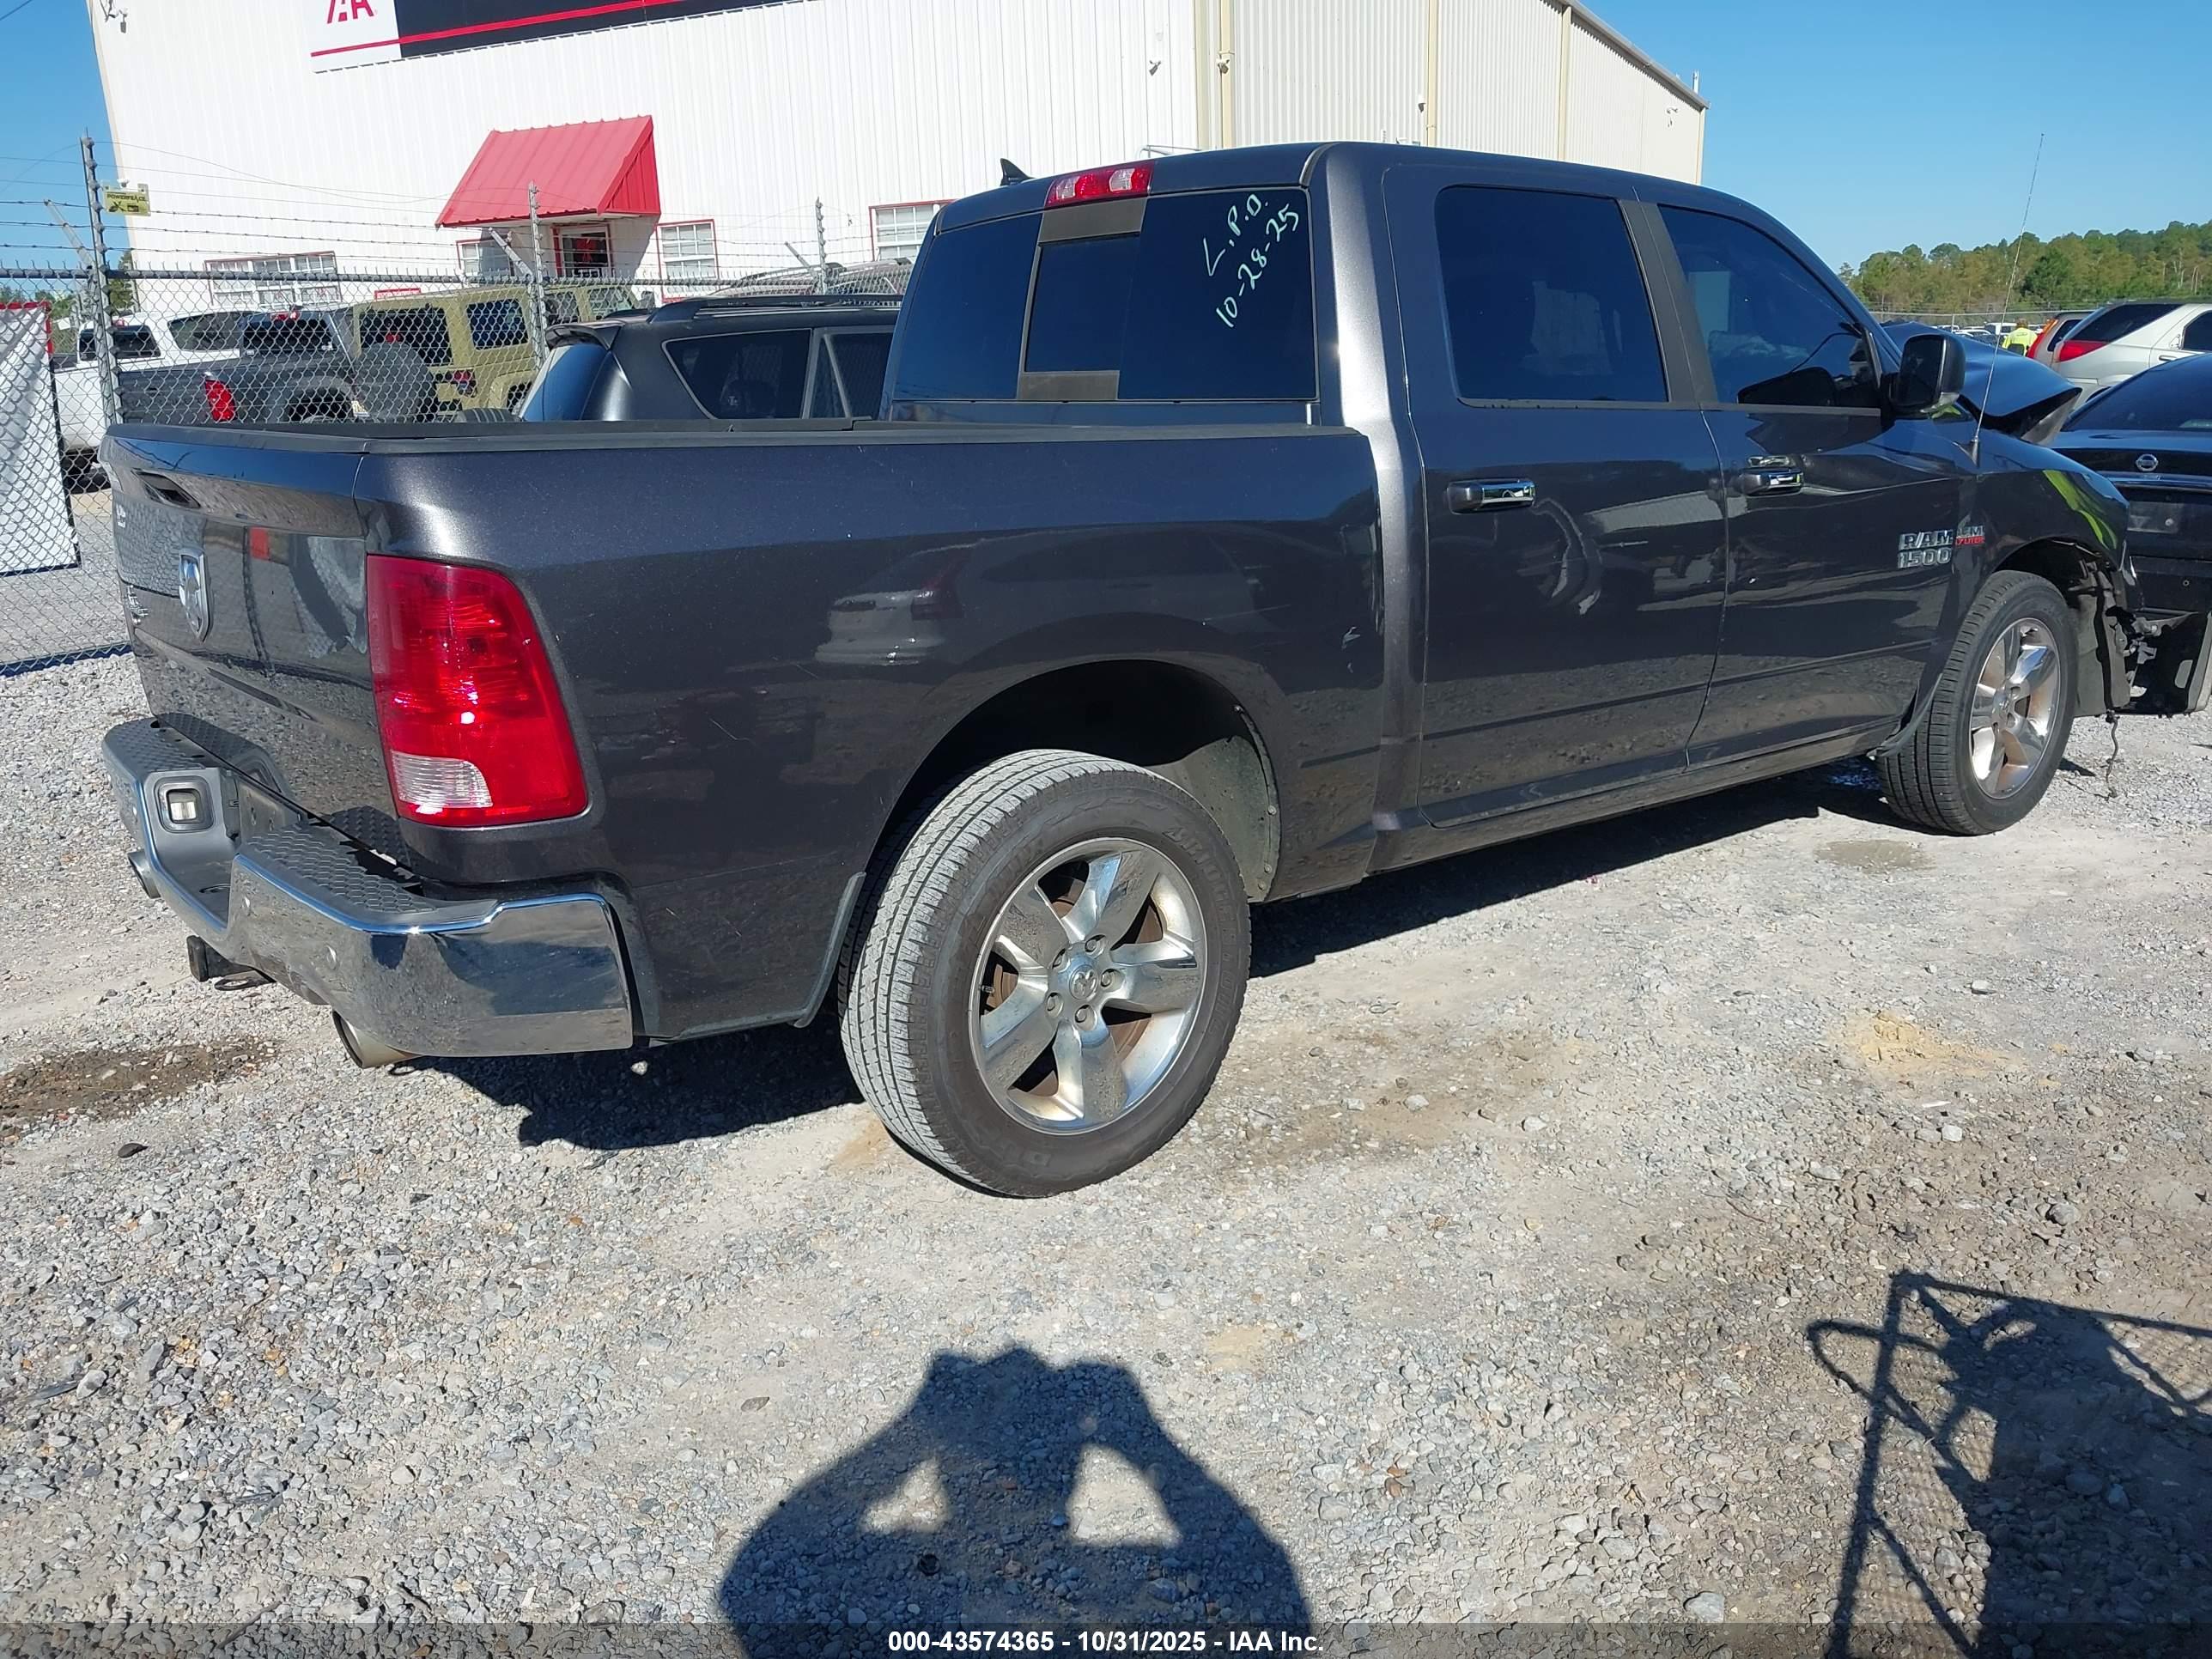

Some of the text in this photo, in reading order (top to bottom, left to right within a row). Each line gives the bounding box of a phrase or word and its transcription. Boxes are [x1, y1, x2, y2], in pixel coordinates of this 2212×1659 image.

[1215, 203, 1299, 328] 10-28-25
[1899, 529, 1954, 550] RAM
[1897, 547, 1953, 568] 1500
